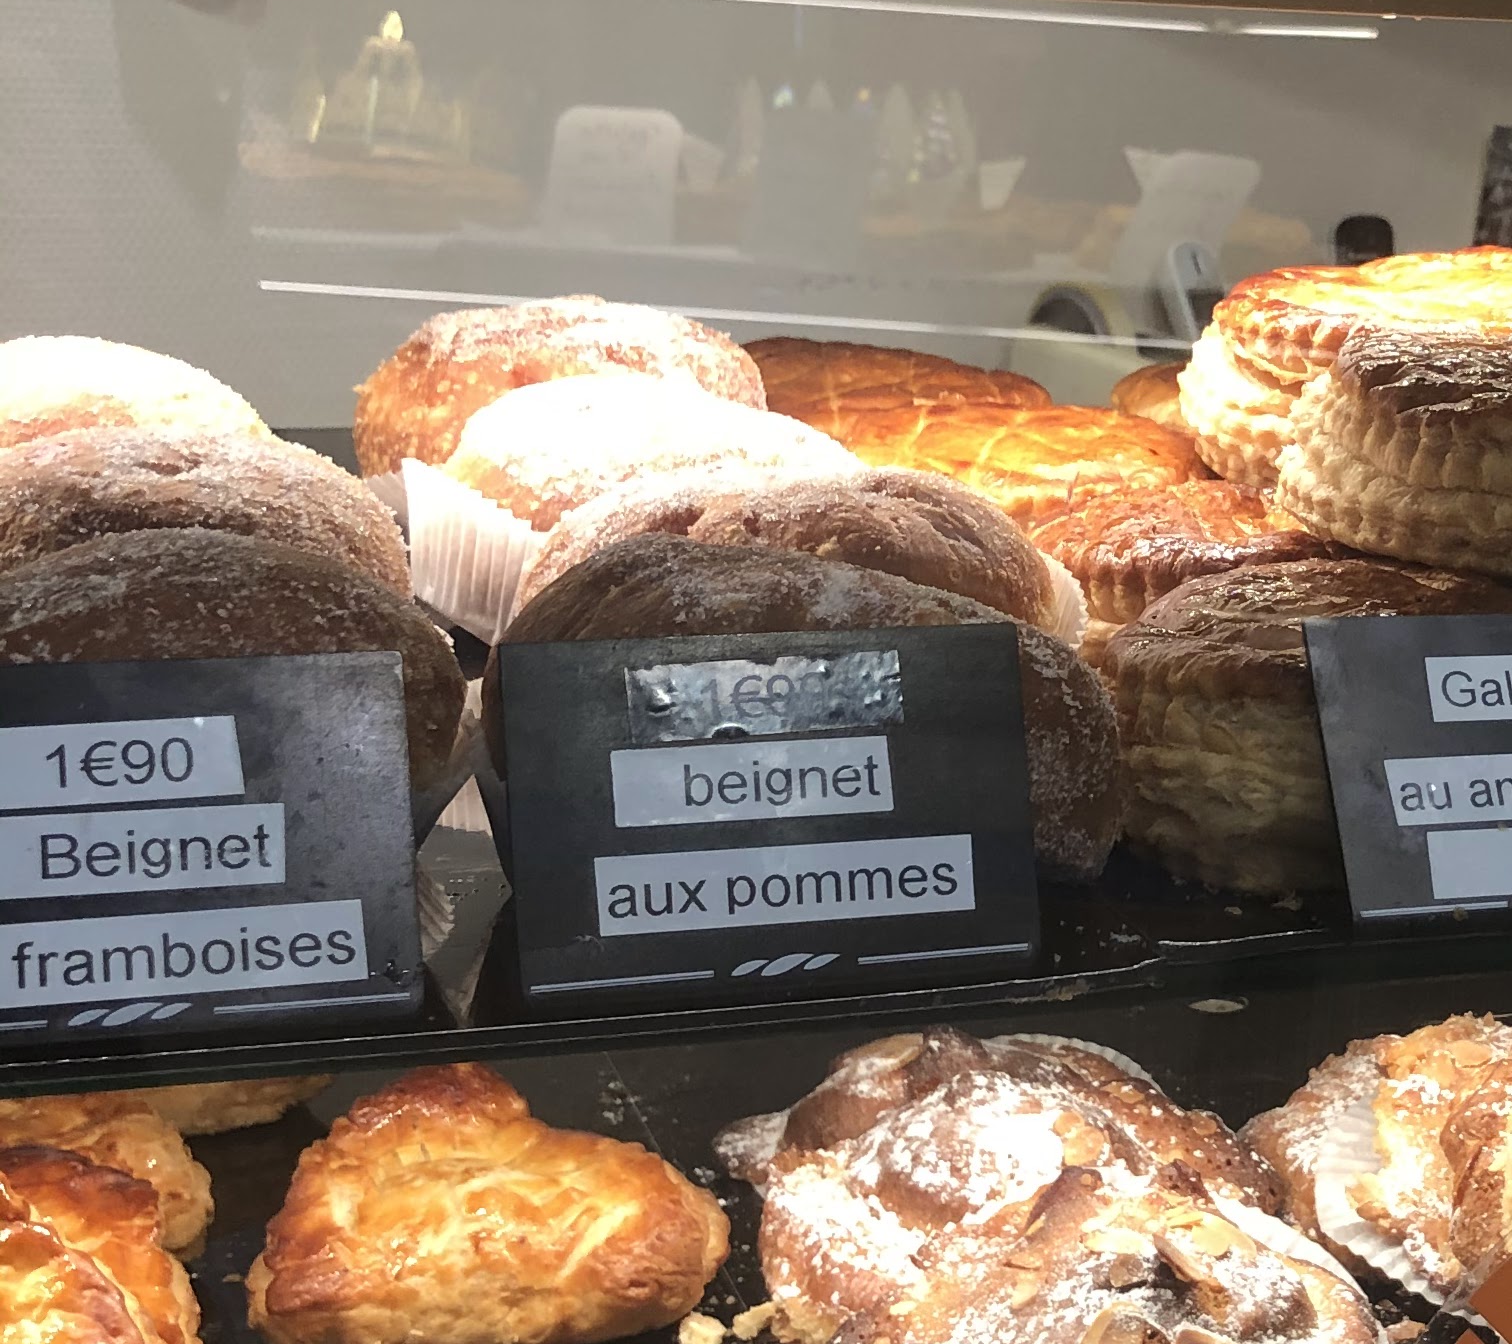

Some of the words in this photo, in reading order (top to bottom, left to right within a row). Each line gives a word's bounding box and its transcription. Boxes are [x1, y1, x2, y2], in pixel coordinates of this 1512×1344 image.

[45, 736, 194, 789] 1€90
[683, 755, 881, 807] beignet
[1400, 782, 1453, 810] au
[40, 823, 273, 892] Beignet
[607, 874, 708, 919] aux
[728, 859, 958, 916] pommes
[12, 927, 358, 989] framboises
